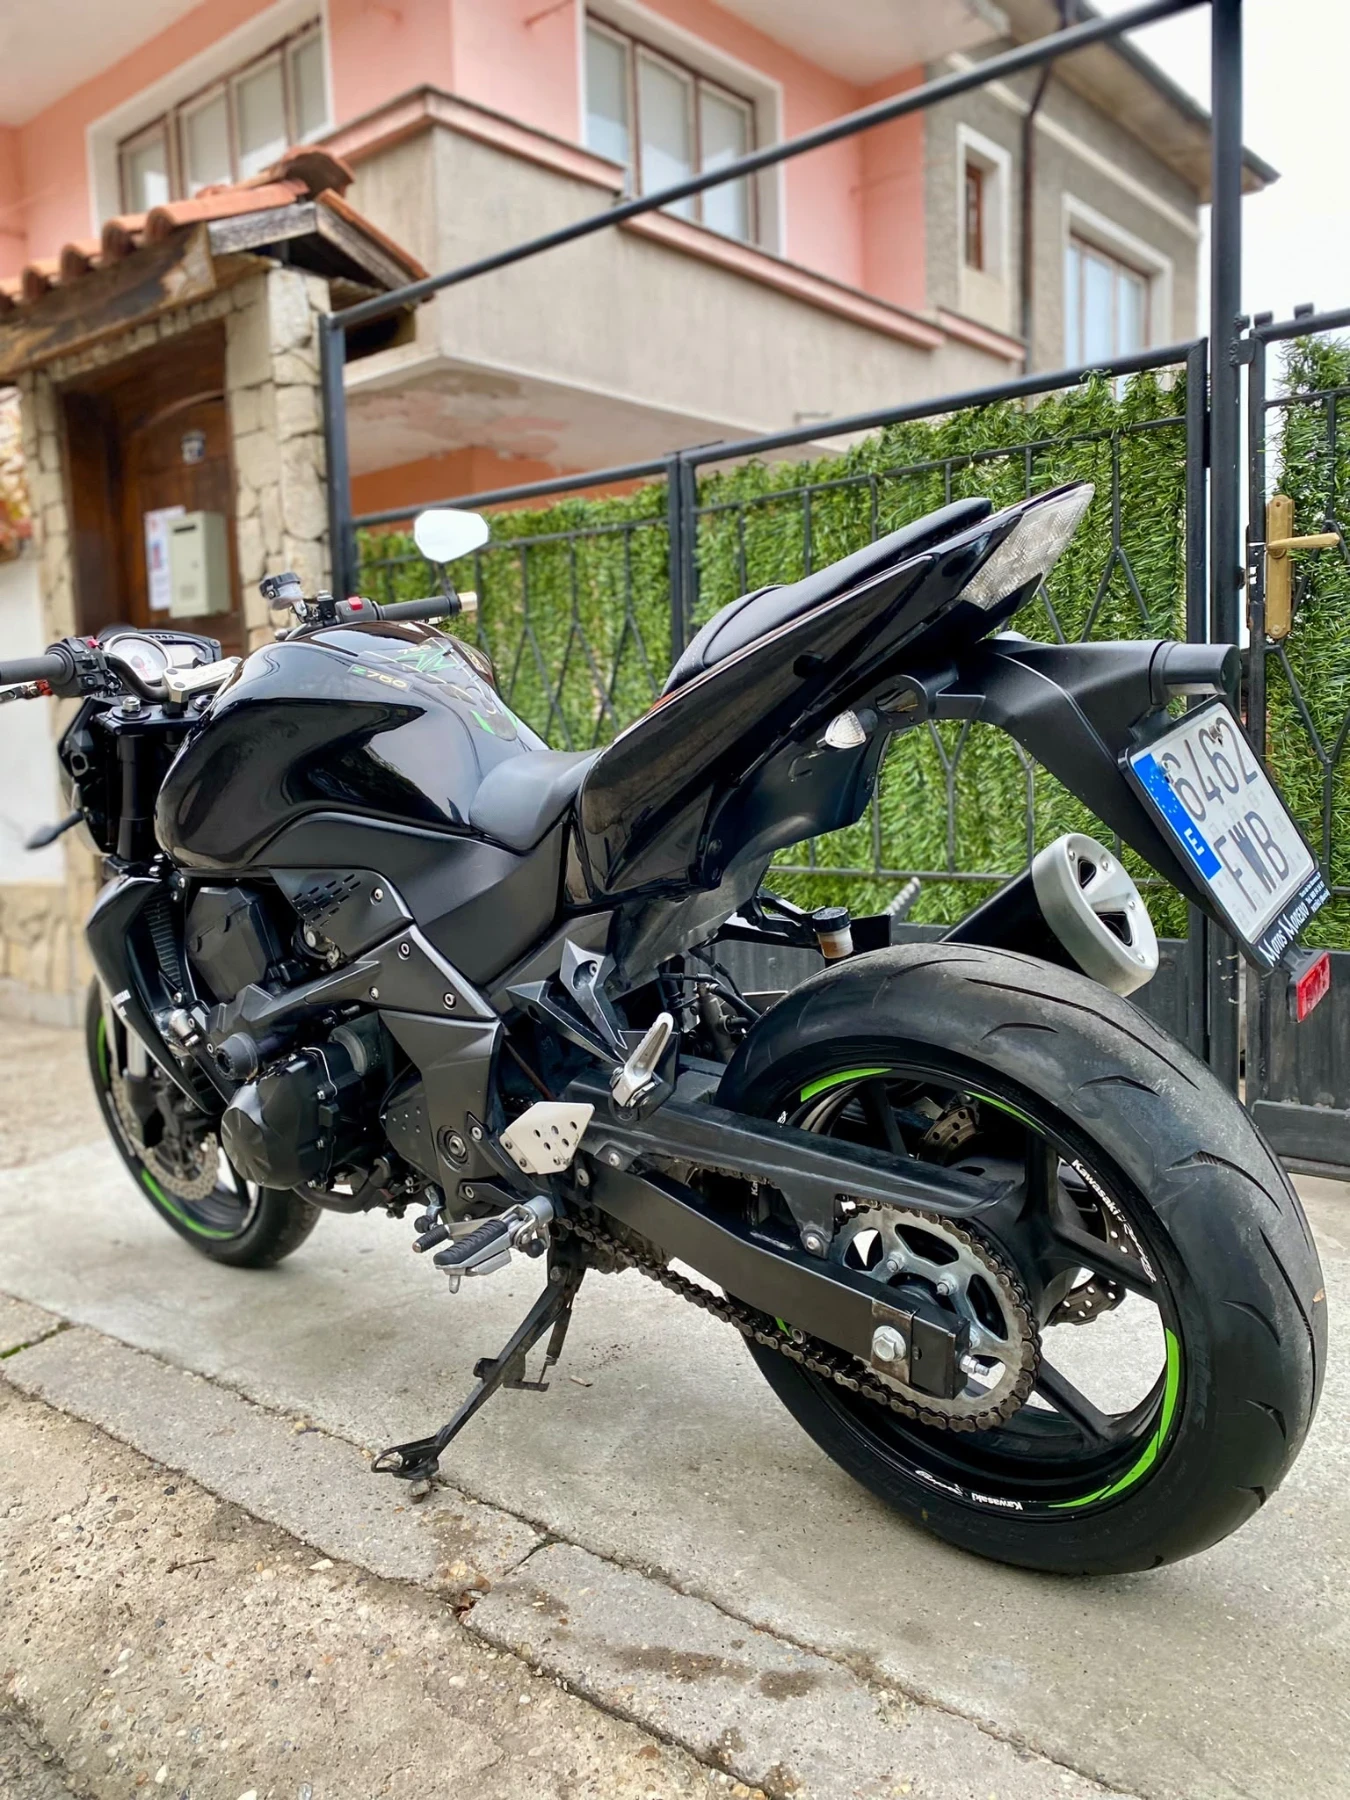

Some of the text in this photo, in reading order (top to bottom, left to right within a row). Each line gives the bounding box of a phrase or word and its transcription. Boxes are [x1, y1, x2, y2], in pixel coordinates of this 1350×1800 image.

[1161, 717, 1258, 822] 6462
[1183, 827, 1205, 856] E
[1213, 810, 1290, 912] FWB
[1071, 1158, 1121, 1216] Kawasaki
[971, 1492, 1024, 1511] Kawasaki
